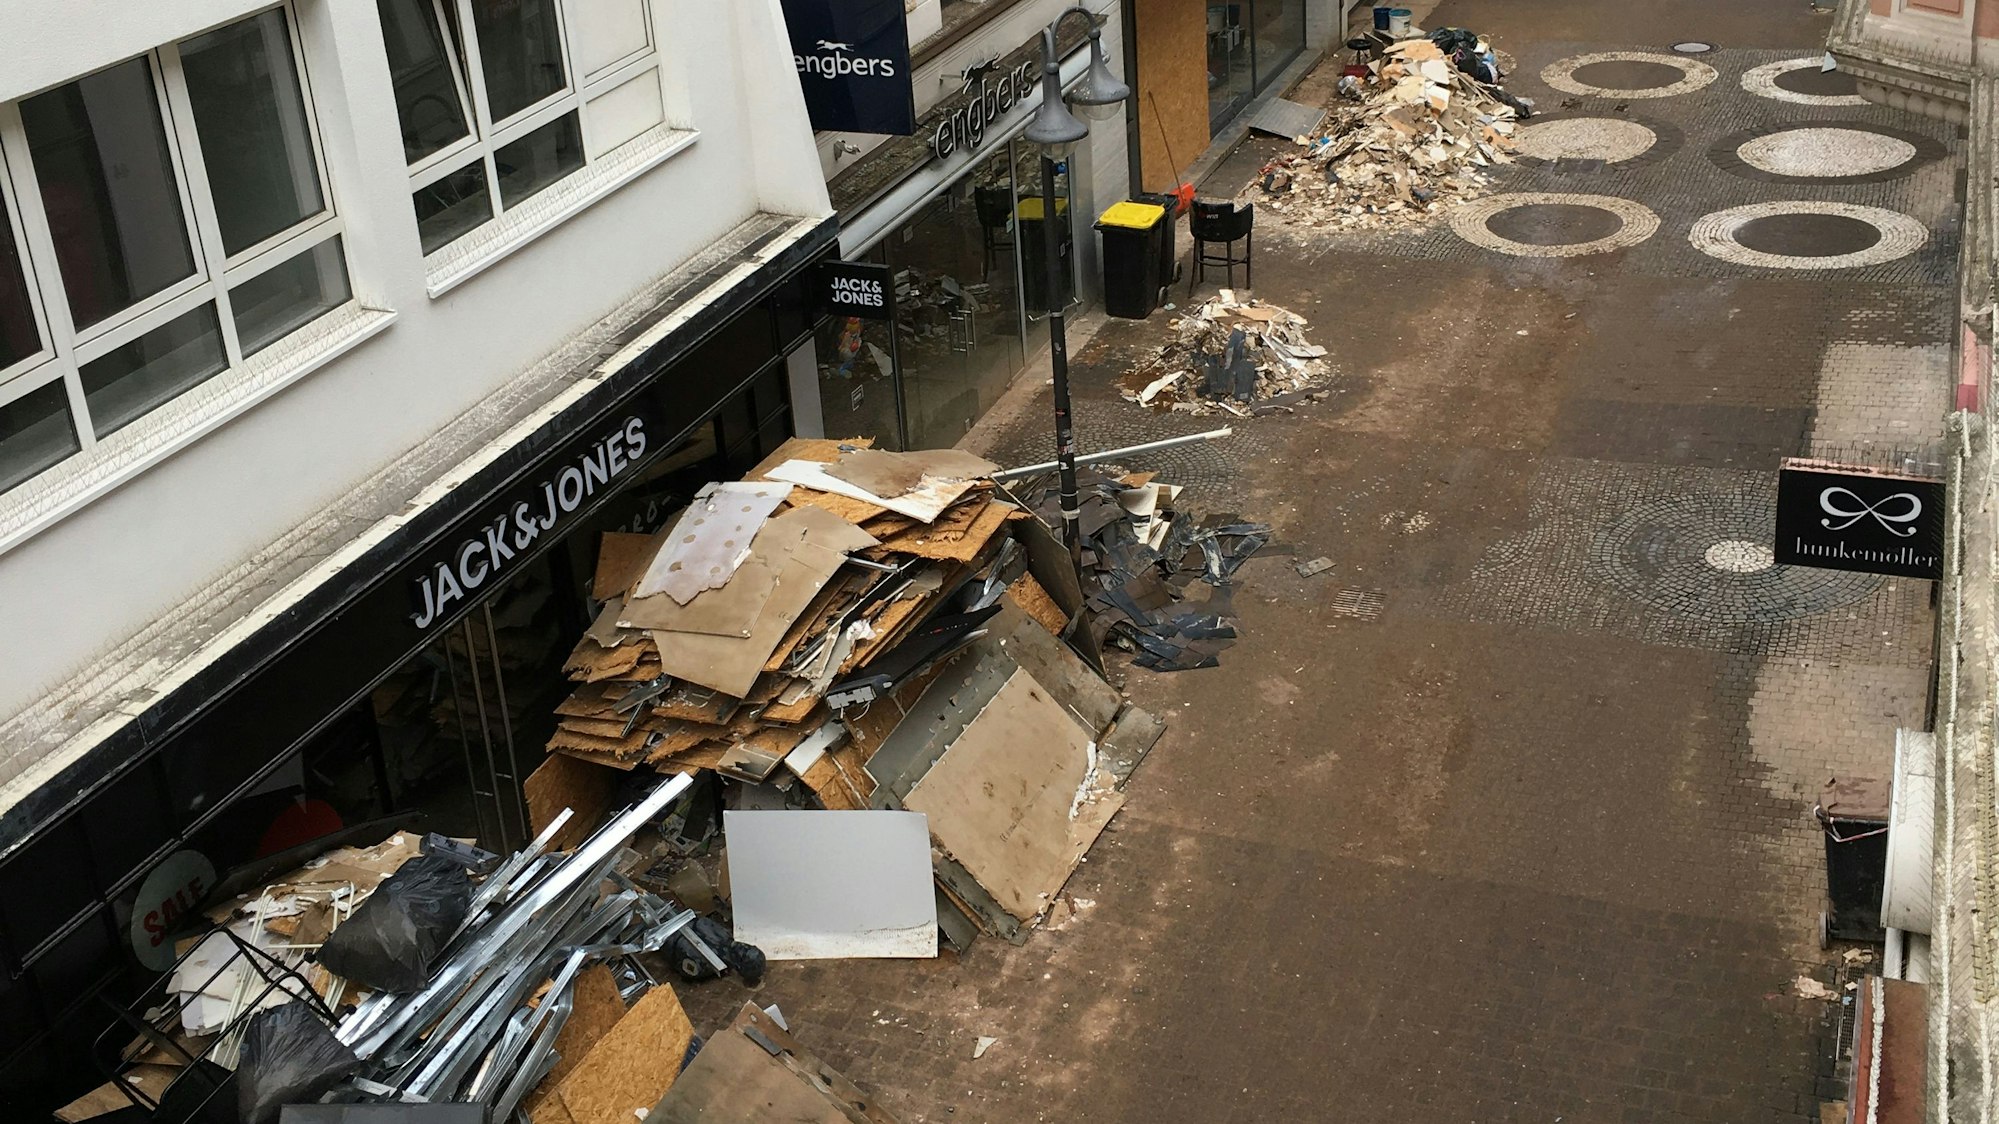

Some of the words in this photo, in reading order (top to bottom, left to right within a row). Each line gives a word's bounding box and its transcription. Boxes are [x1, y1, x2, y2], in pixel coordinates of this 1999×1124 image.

[794, 51, 895, 79] engbers
[935, 60, 1034, 160] engbers
[831, 277, 883, 294] JACK&
[832, 290, 884, 307] JONES
[411, 416, 647, 629] JACK&JONES
